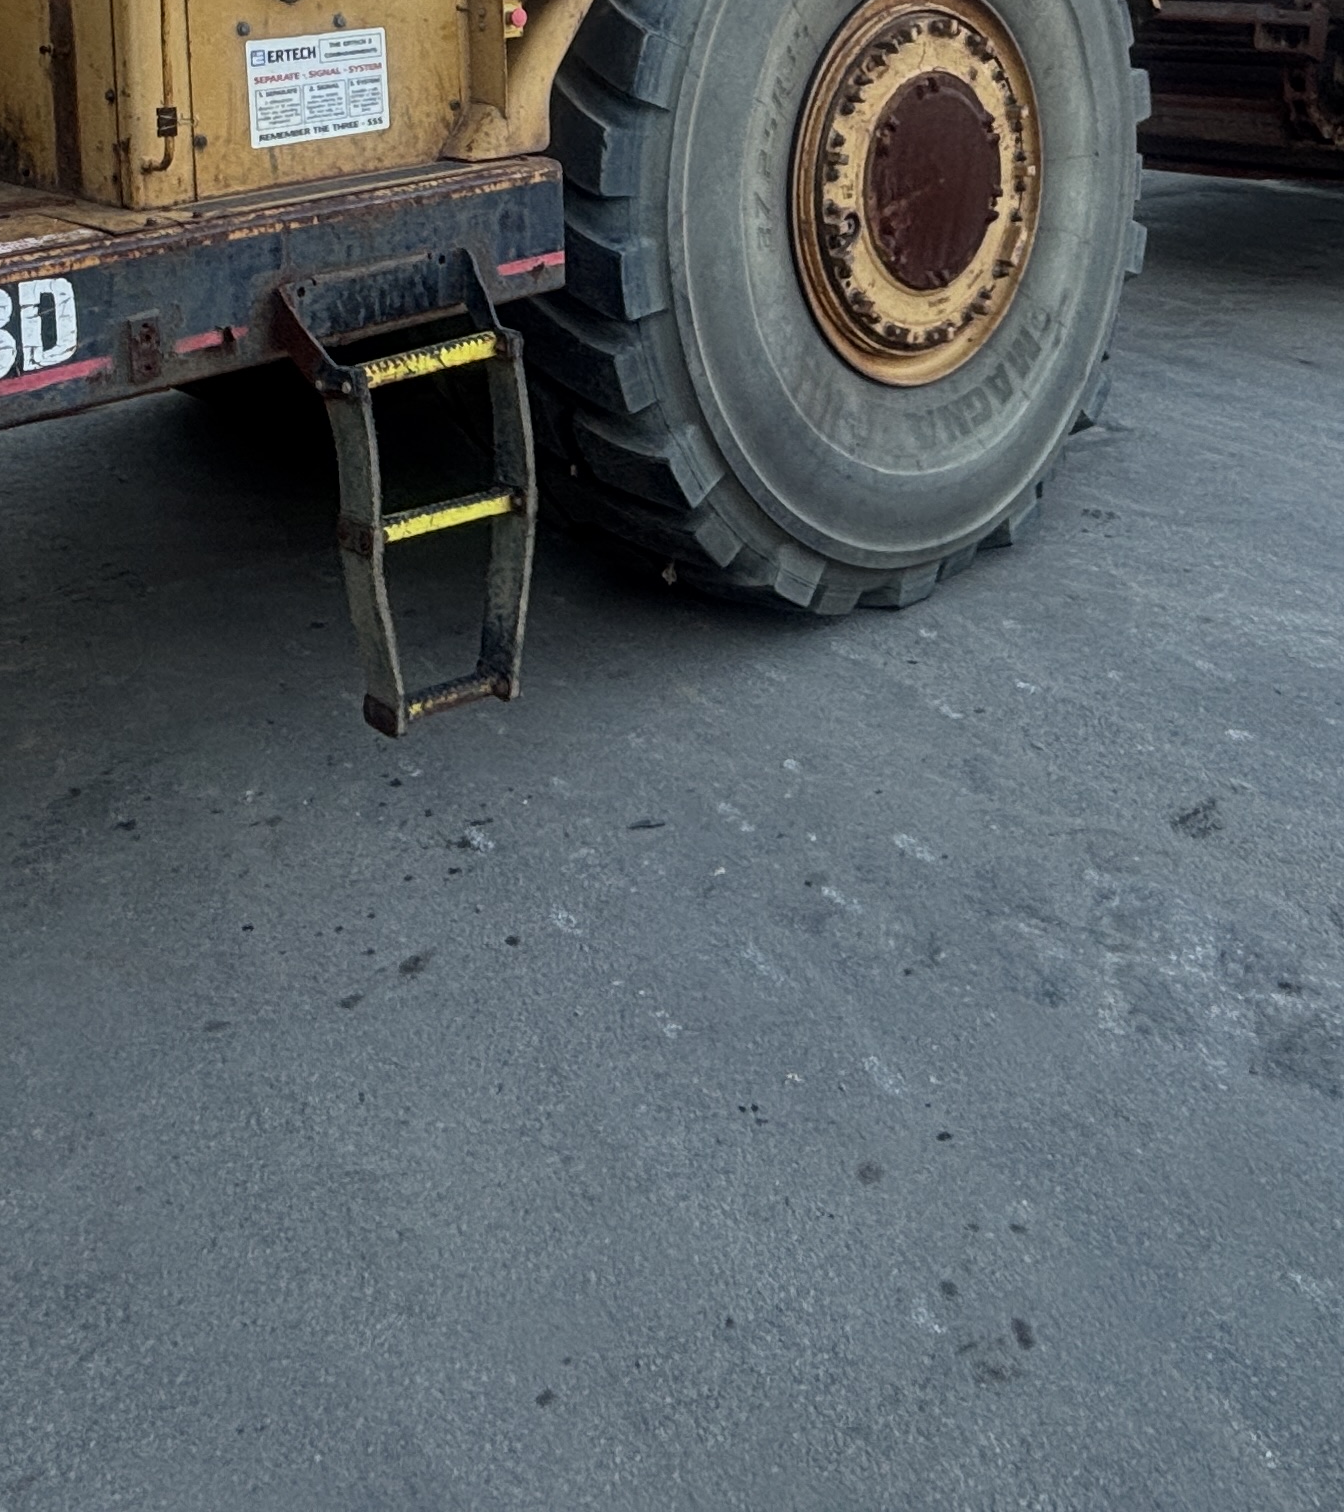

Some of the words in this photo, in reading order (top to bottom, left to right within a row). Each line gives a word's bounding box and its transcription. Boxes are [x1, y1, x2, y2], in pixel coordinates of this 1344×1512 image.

[267, 46, 317, 64] ERTECH
[253, 71, 301, 85] SEPARATE
[308, 67, 341, 79] SIGNAL
[348, 62, 383, 74] SYSTEM
[259, 128, 311, 142] REMEMBER
[313, 125, 330, 135] THE
[332, 120, 359, 132] THREE
